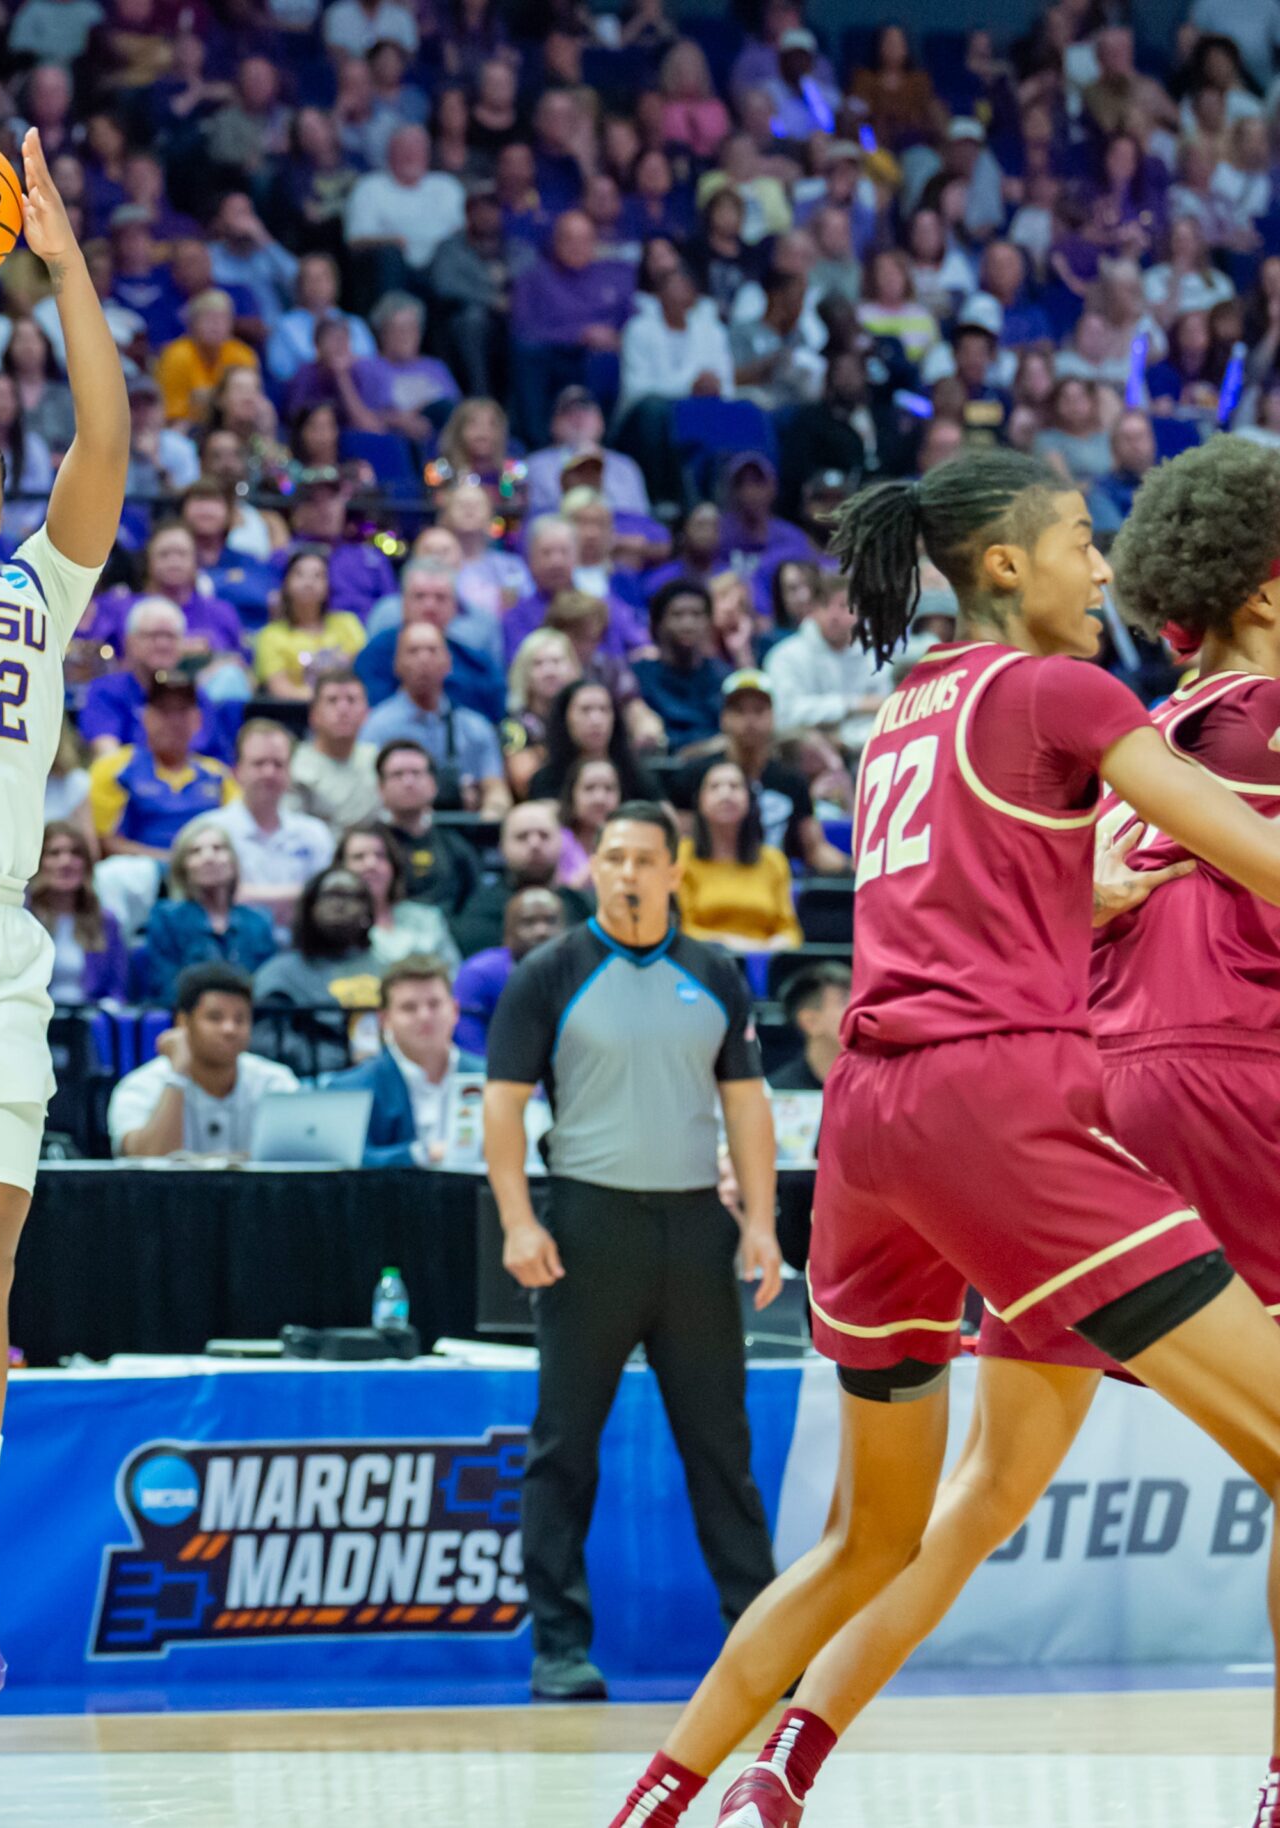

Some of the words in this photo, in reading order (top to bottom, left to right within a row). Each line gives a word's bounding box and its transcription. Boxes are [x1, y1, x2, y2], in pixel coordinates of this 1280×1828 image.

[855, 735, 939, 891] 22
[200, 1453, 435, 1532] MARCH
[225, 1530, 530, 1611] MADNESS
